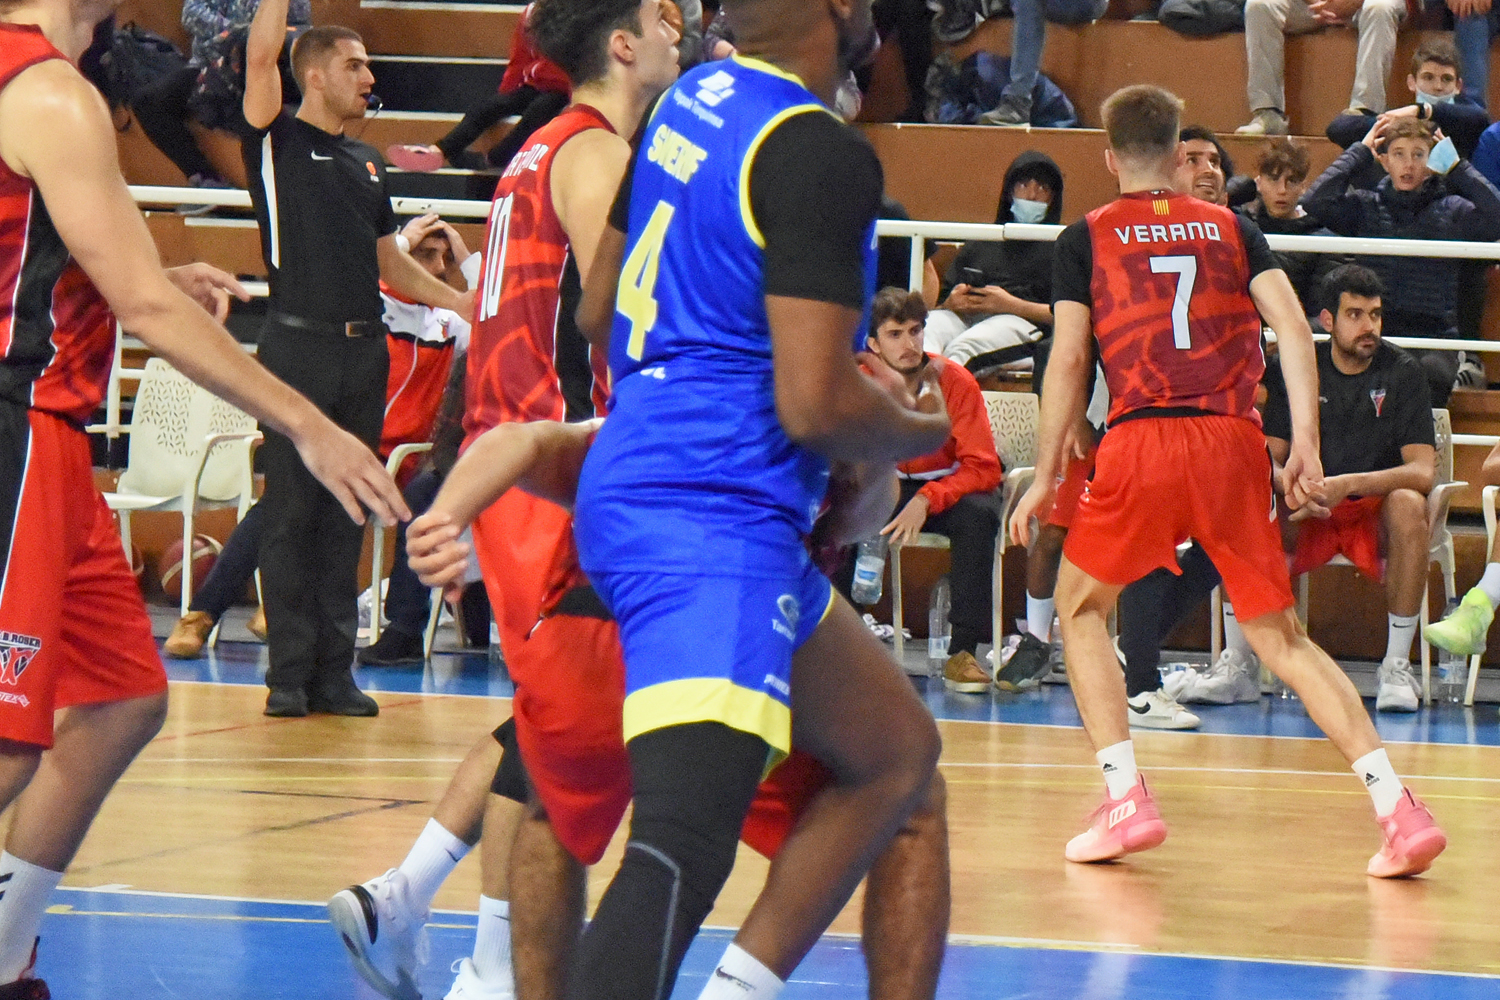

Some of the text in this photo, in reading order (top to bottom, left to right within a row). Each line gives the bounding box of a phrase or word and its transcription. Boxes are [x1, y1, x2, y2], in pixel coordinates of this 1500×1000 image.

[479, 191, 514, 322] 10
[616, 199, 676, 363] 4
[1113, 221, 1222, 246] VERANO
[1149, 254, 1197, 350] 7
